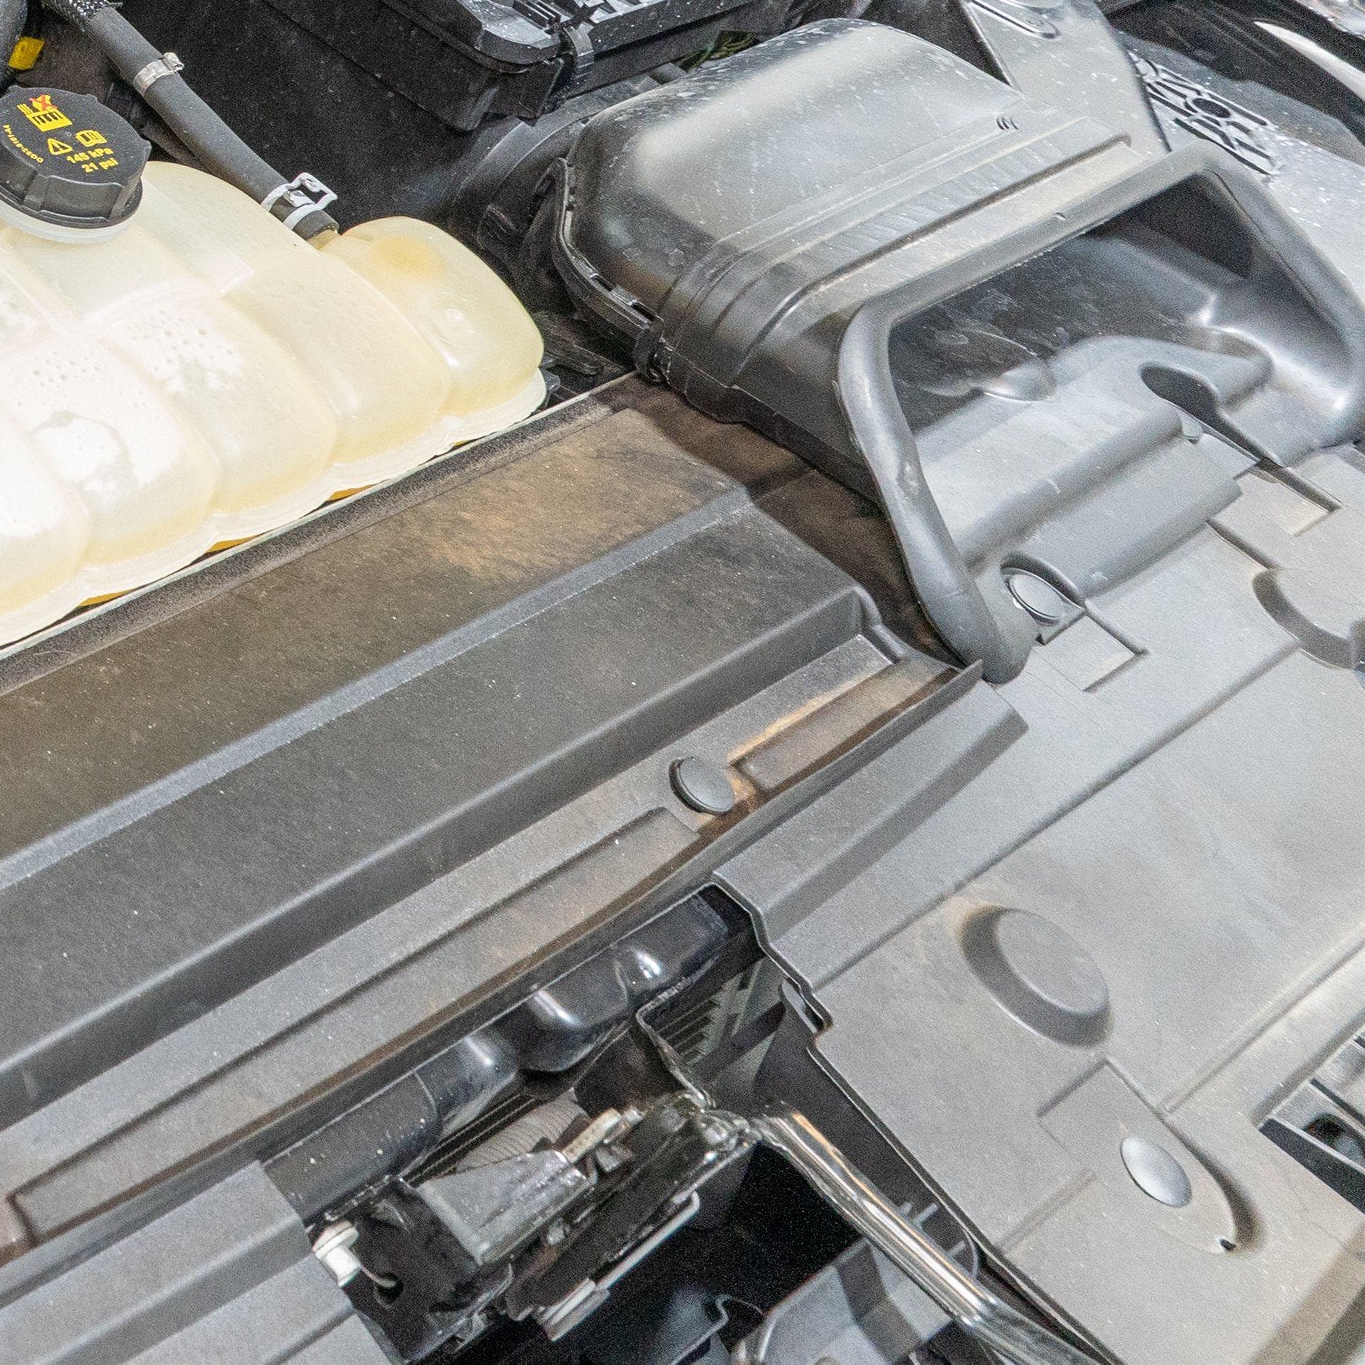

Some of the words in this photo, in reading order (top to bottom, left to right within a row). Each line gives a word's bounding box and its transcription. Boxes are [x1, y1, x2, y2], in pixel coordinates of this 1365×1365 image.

[66, 152, 90, 164] 145
[87, 148, 114, 158] kPa
[81, 162, 99, 173] 21
[99, 157, 119, 170] psi
